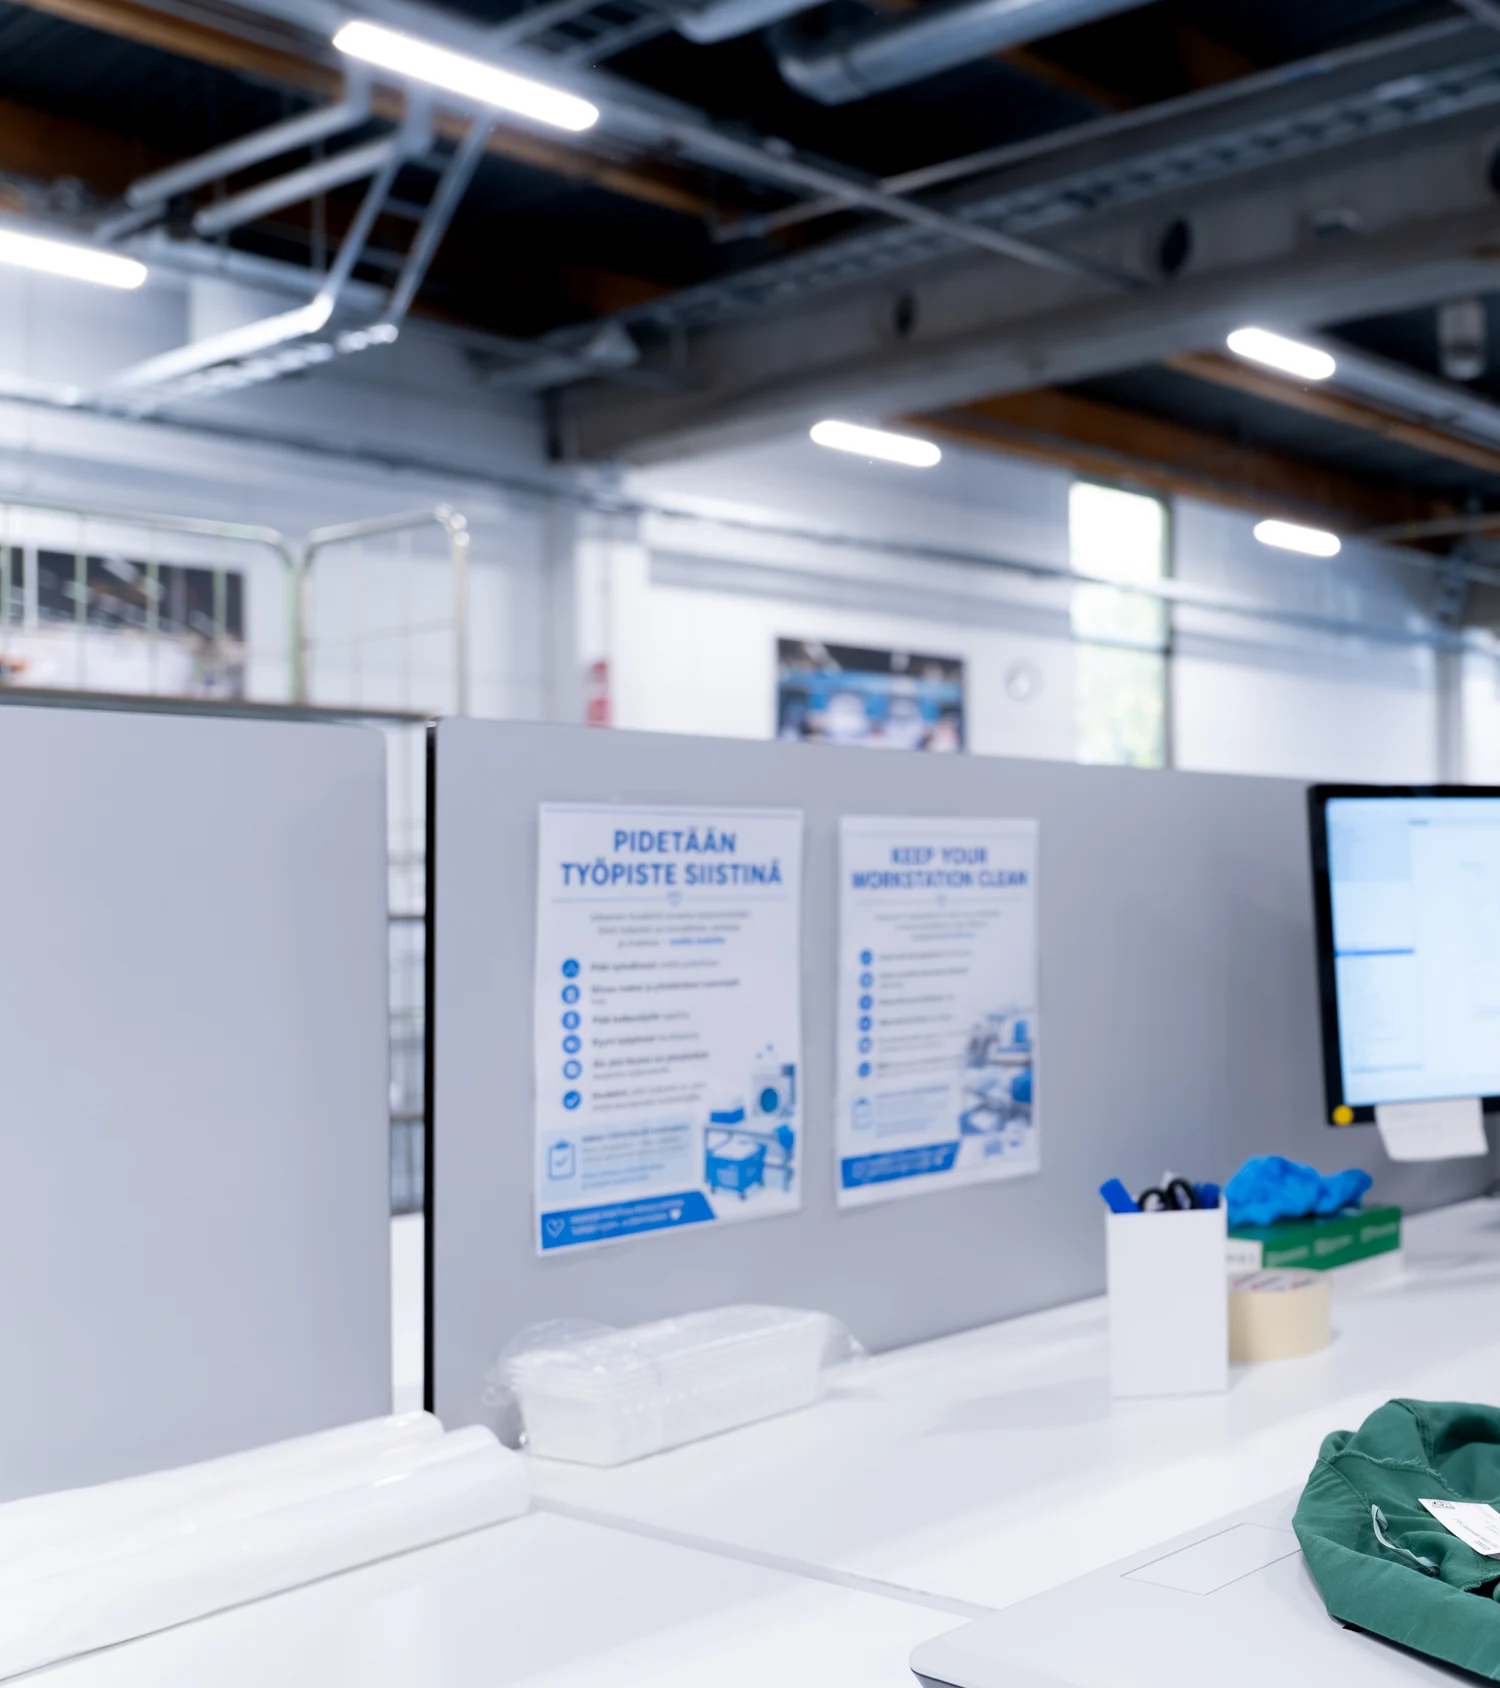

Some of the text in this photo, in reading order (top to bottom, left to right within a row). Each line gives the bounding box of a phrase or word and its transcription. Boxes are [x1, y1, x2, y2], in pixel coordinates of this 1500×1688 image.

[613, 826, 737, 853] PIDETÄÄN
[891, 846, 988, 865] KEEP YOUR
[561, 857, 782, 886] TYÖPISTE SIISTINÄ
[852, 870, 1028, 889] WORKSTATION CLEAN
